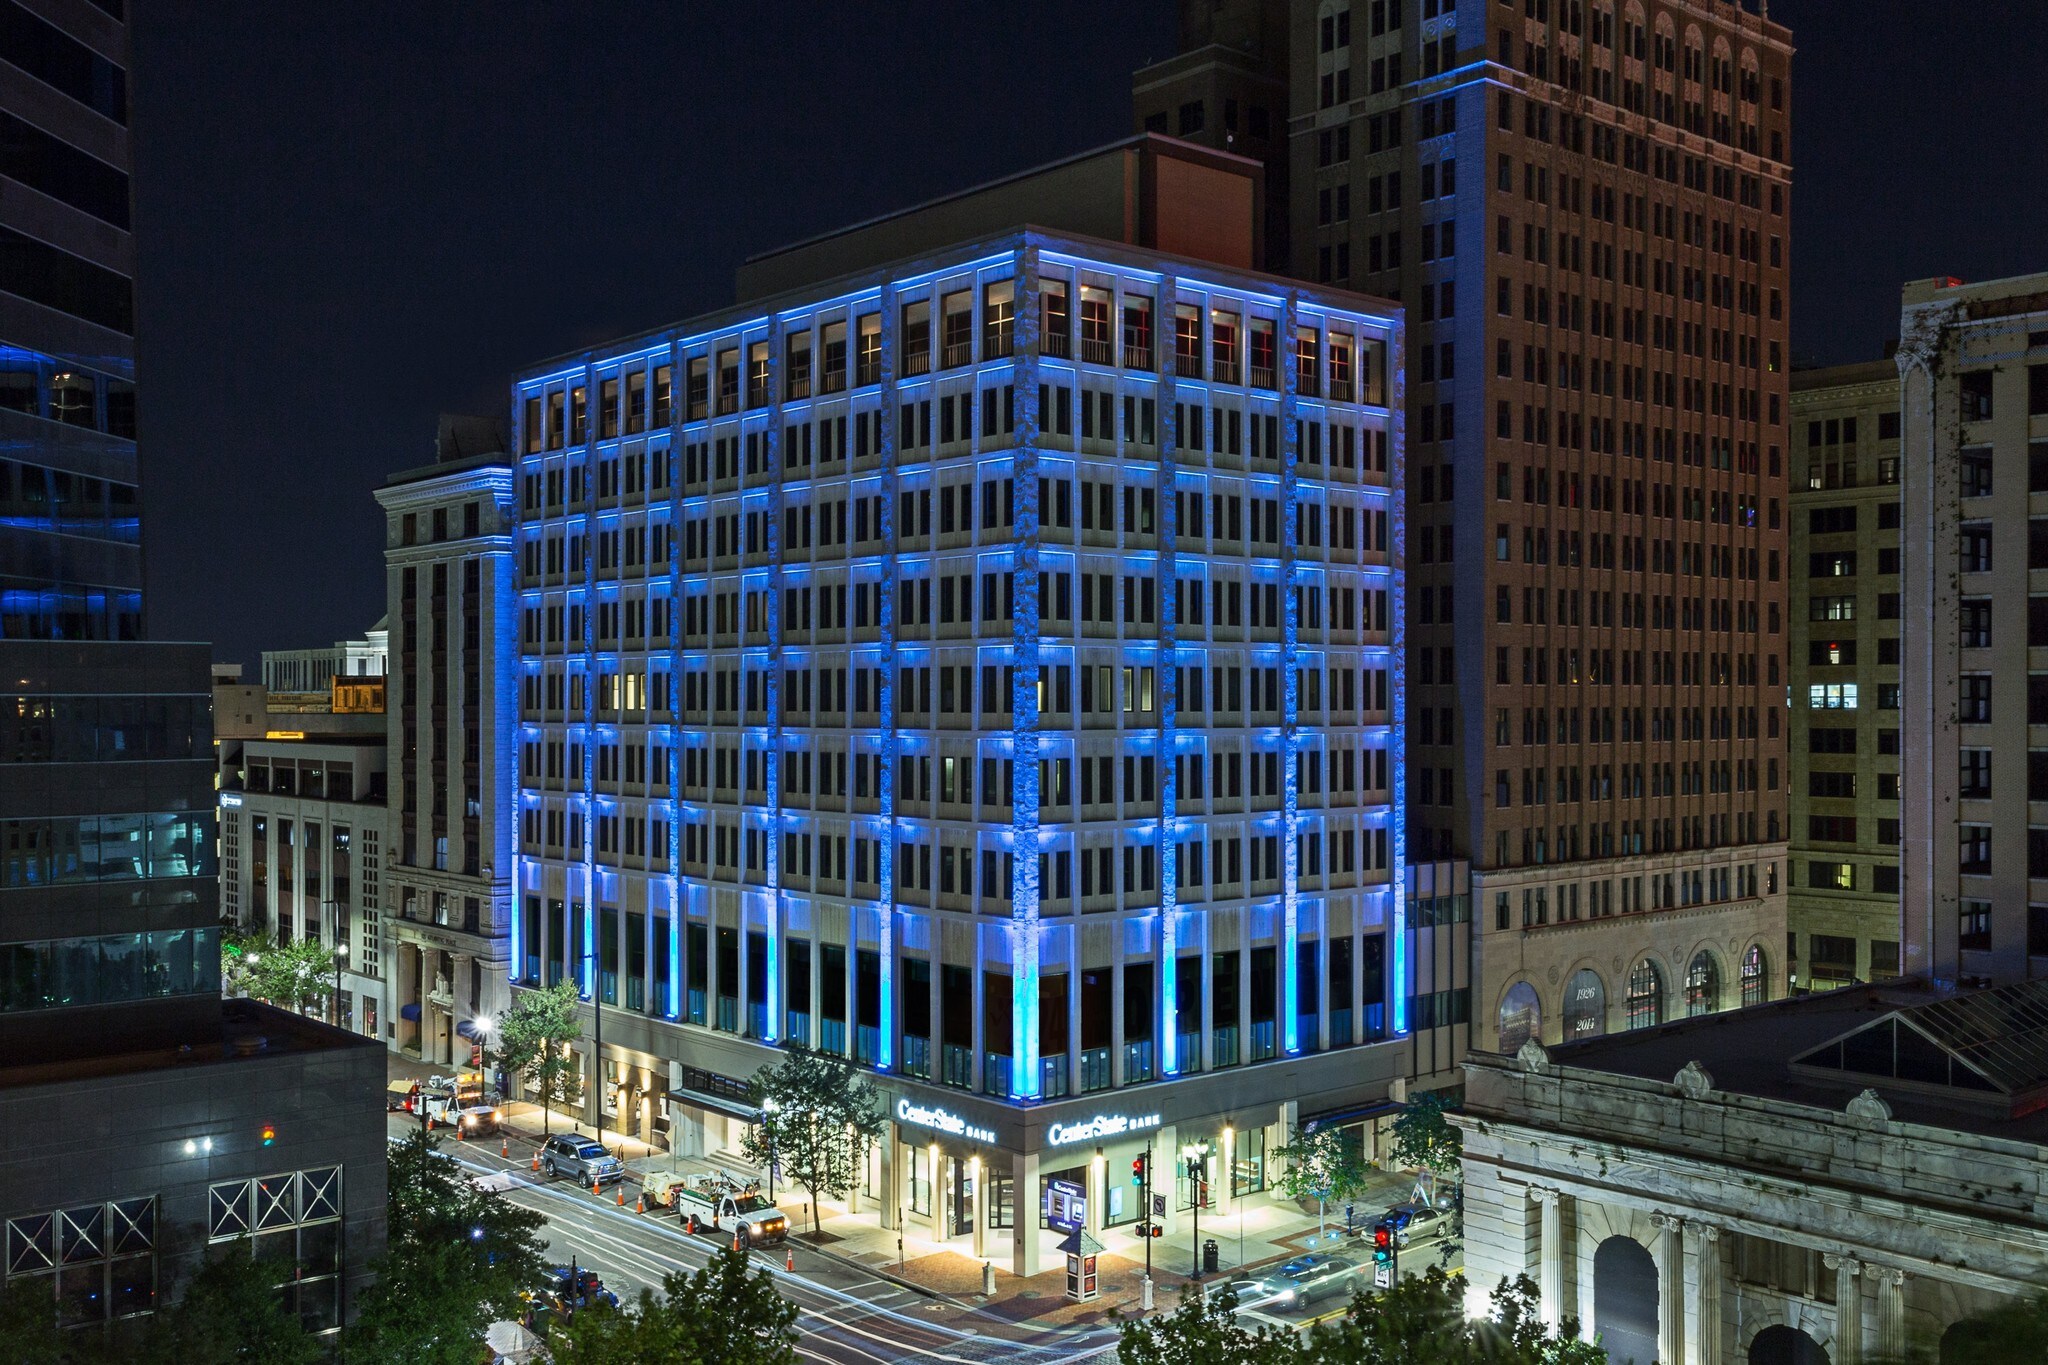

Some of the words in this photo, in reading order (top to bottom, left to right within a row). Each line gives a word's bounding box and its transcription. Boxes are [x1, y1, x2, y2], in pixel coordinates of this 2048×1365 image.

[1576, 987, 1595, 1000] 1926
[1576, 1017, 1595, 1031] 2014
[898, 1099, 965, 1134] CenterState
[966, 1126, 995, 1143] BANK
[1049, 1115, 1127, 1145] CenterState
[1129, 1114, 1160, 1130] BANK
